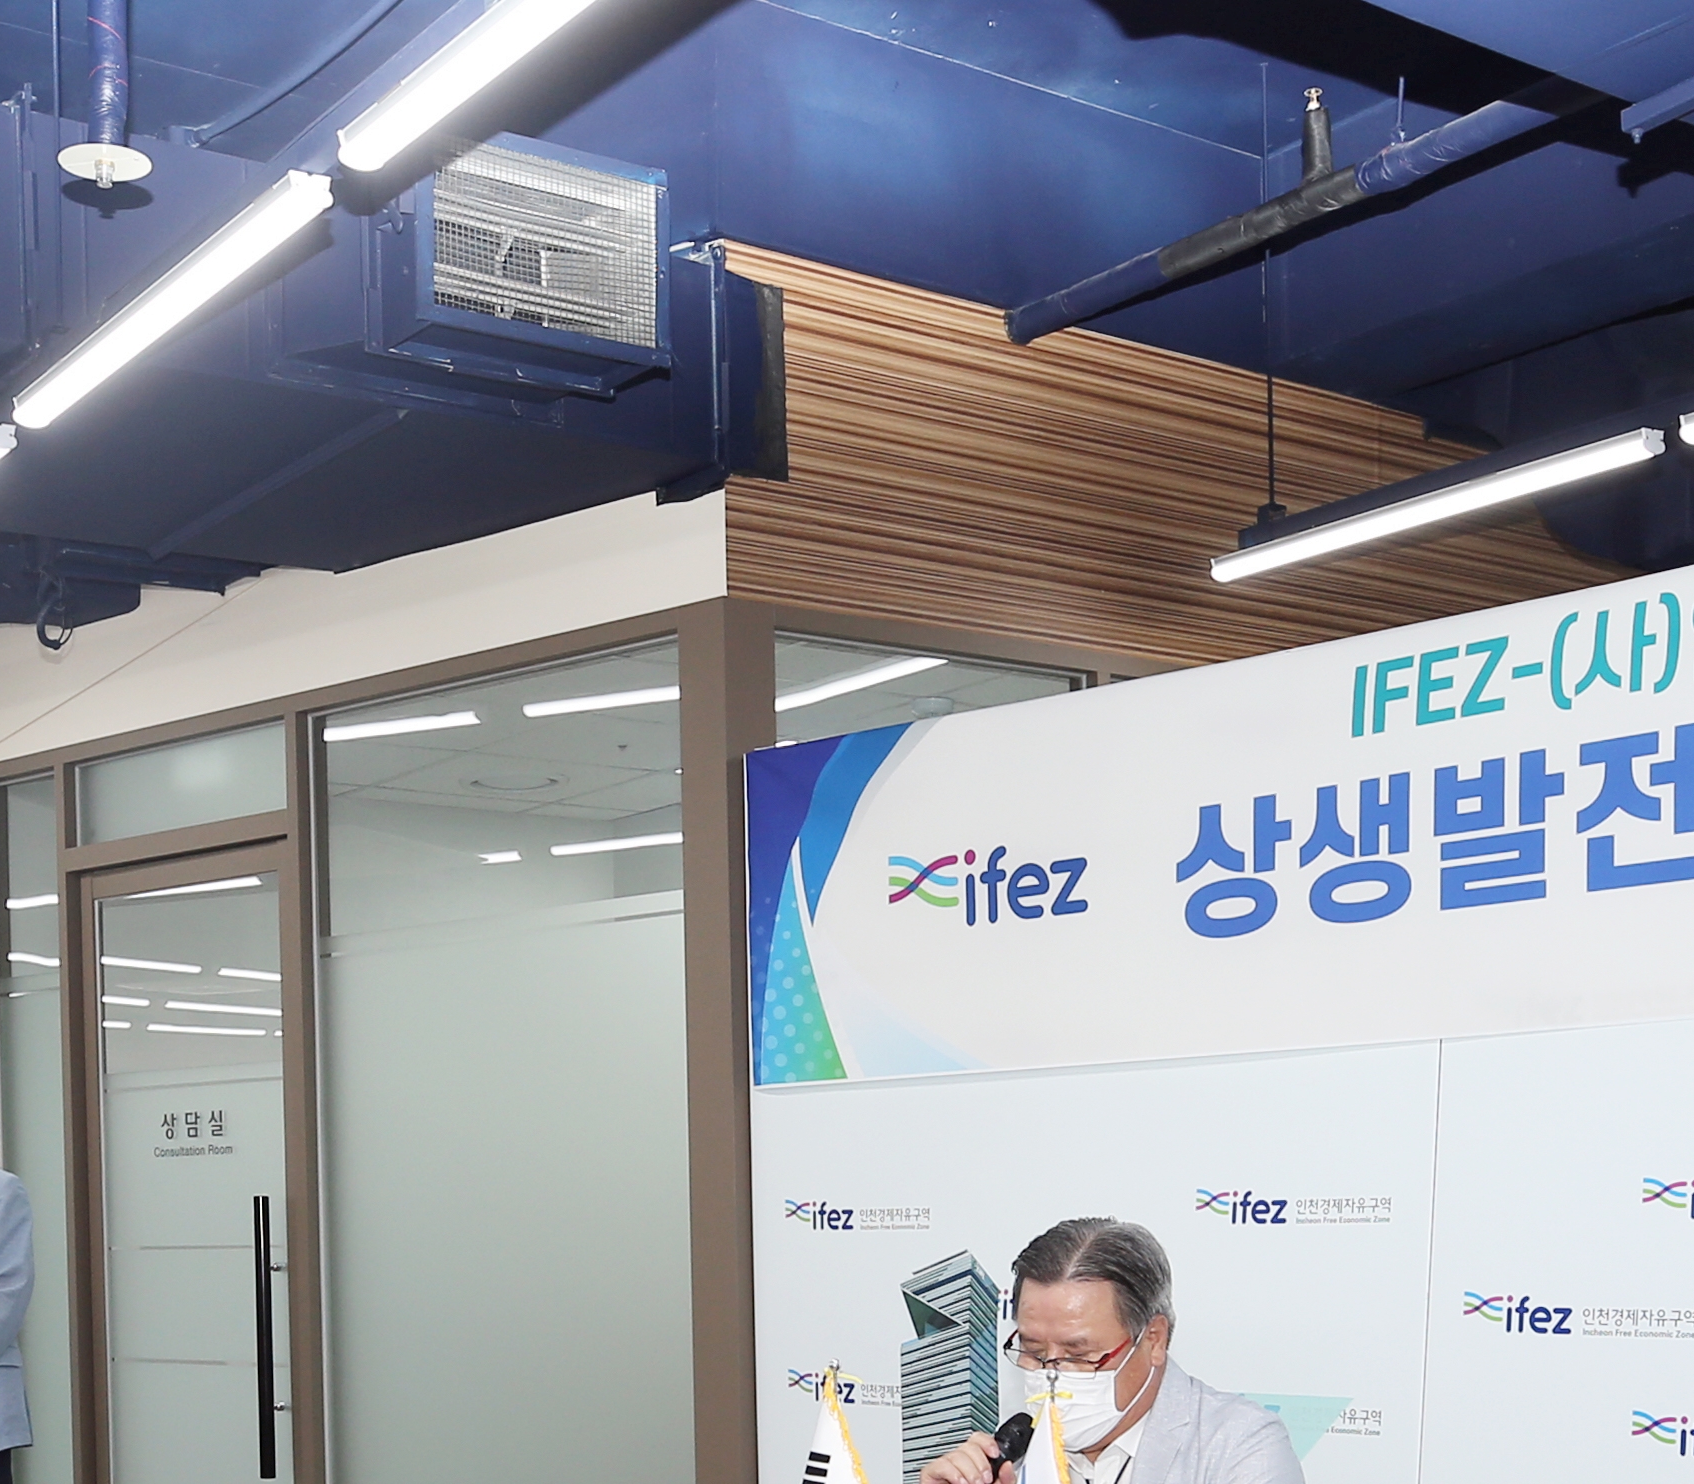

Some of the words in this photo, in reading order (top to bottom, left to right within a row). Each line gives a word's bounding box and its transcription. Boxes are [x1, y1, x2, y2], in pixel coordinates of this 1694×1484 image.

[964, 845, 1090, 927] ifez
[161, 1110, 225, 1140] 상담실
[154, 1146, 206, 1158] Consultation
[208, 1144, 233, 1155] Room
[812, 1200, 854, 1231] ifez
[859, 1207, 931, 1223] 인천경제자유구역
[1232, 1190, 1288, 1225] ifez
[1295, 1196, 1392, 1215] 인천경제자유구역
[1506, 1294, 1573, 1334] ifez
[1582, 1328, 1614, 1337] Incheon
[1614, 1328, 1633, 1337] Free
[1634, 1329, 1673, 1338] Economic
[815, 1372, 855, 1404] iz
